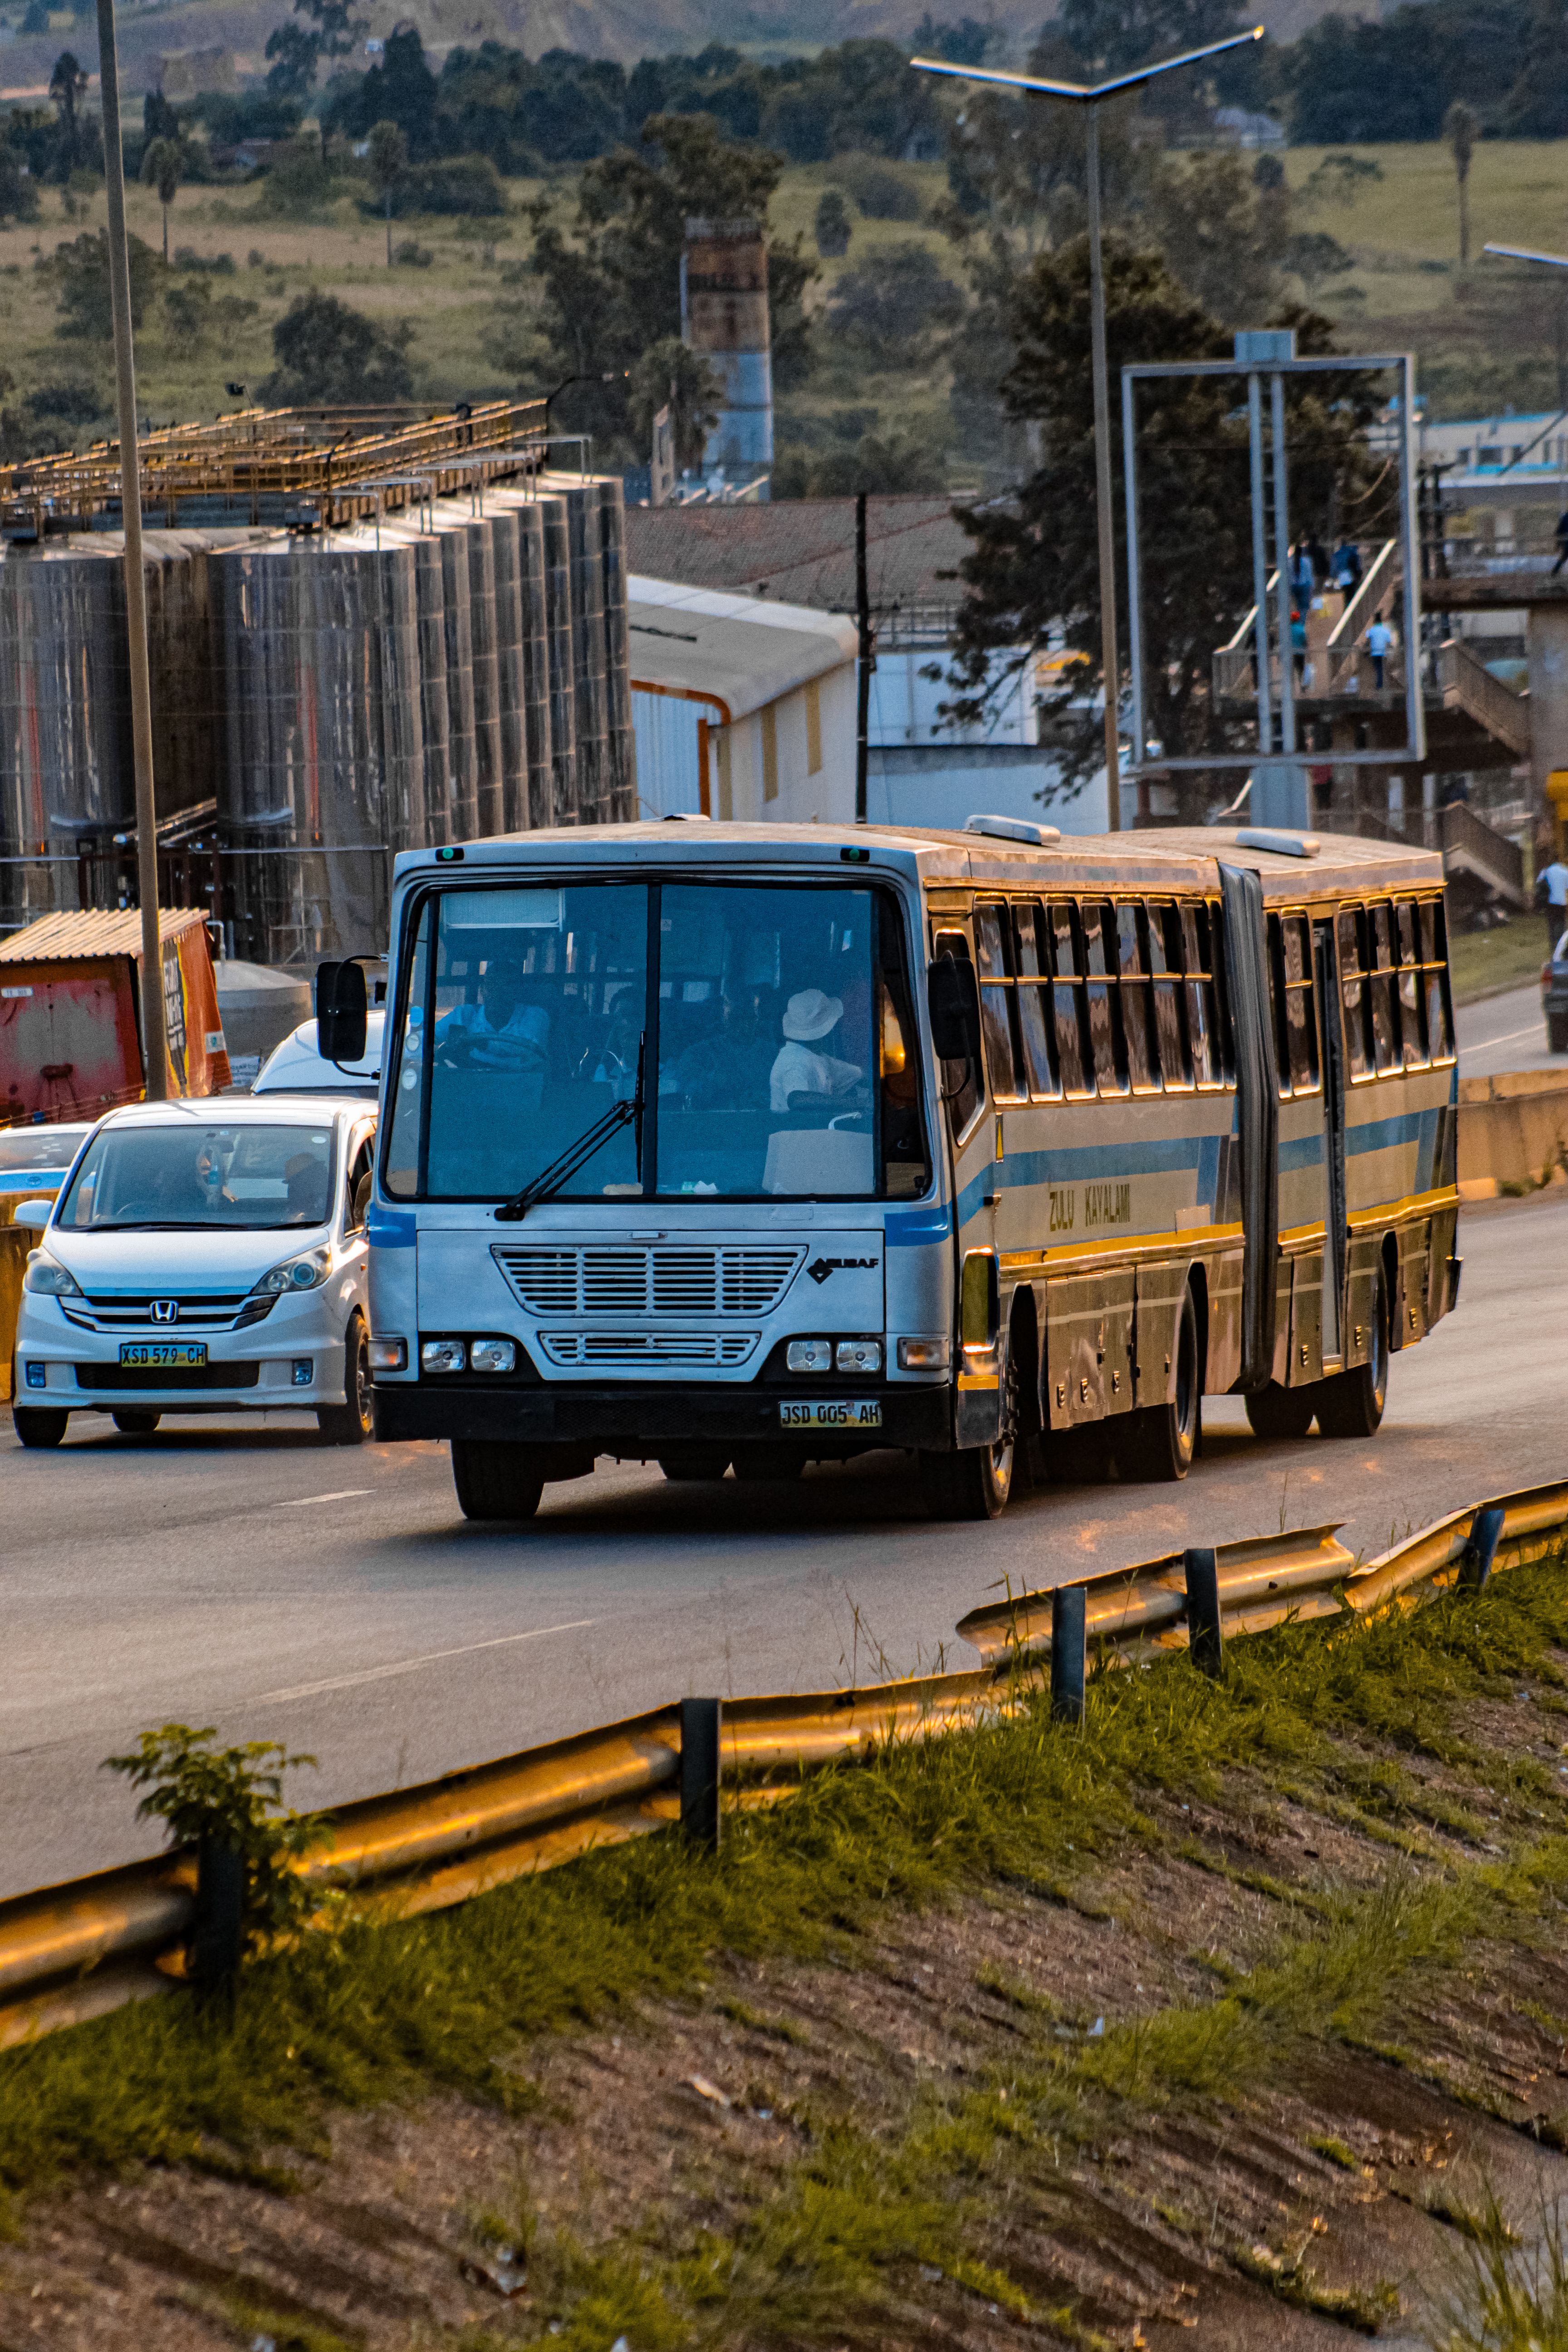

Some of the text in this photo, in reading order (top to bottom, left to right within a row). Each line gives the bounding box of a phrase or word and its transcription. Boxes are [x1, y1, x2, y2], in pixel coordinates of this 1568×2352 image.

[1049, 1183, 1130, 1232] ZULU KAYALAMI
[122, 1347, 205, 1364] XSD 579 CH
[782, 1404, 879, 1425] JSD 005 AH
